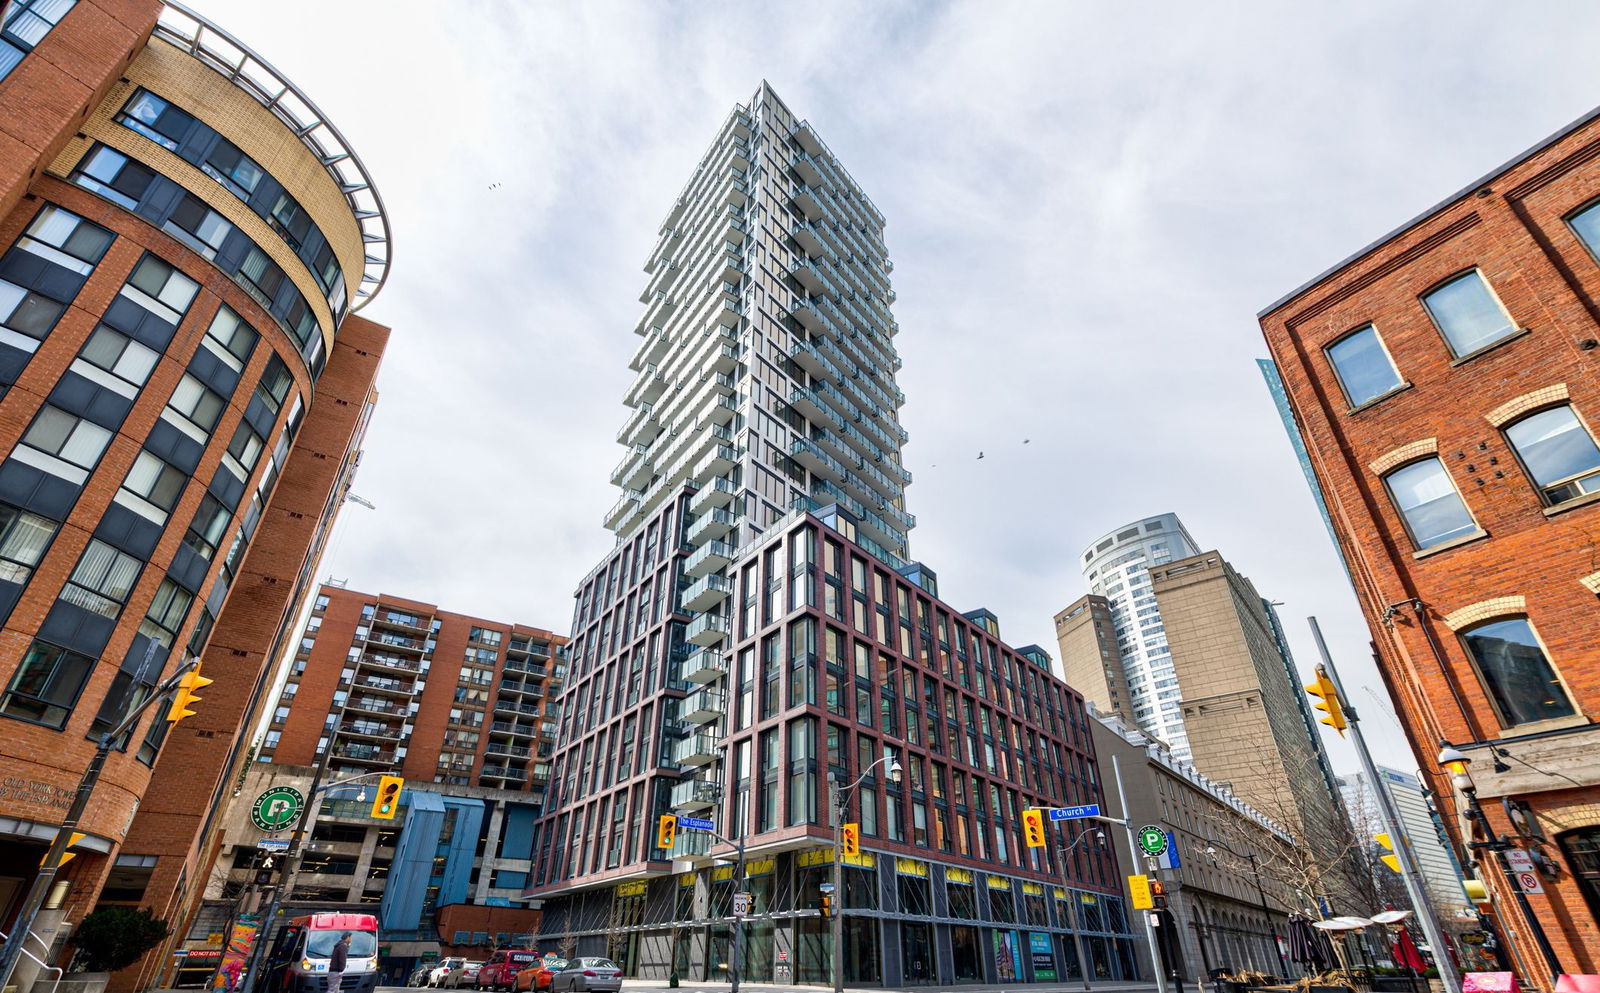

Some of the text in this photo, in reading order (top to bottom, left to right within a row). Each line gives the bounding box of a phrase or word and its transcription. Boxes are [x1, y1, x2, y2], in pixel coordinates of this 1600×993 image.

[4, 776, 77, 801] OLD YORK TOWE
[30, 791, 72, 810] ESPLANAD
[267, 799, 290, 817] P
[1056, 807, 1085, 818] Church
[680, 816, 713, 830] The Esplanade
[1145, 833, 1159, 847] P
[735, 902, 746, 913] 30
